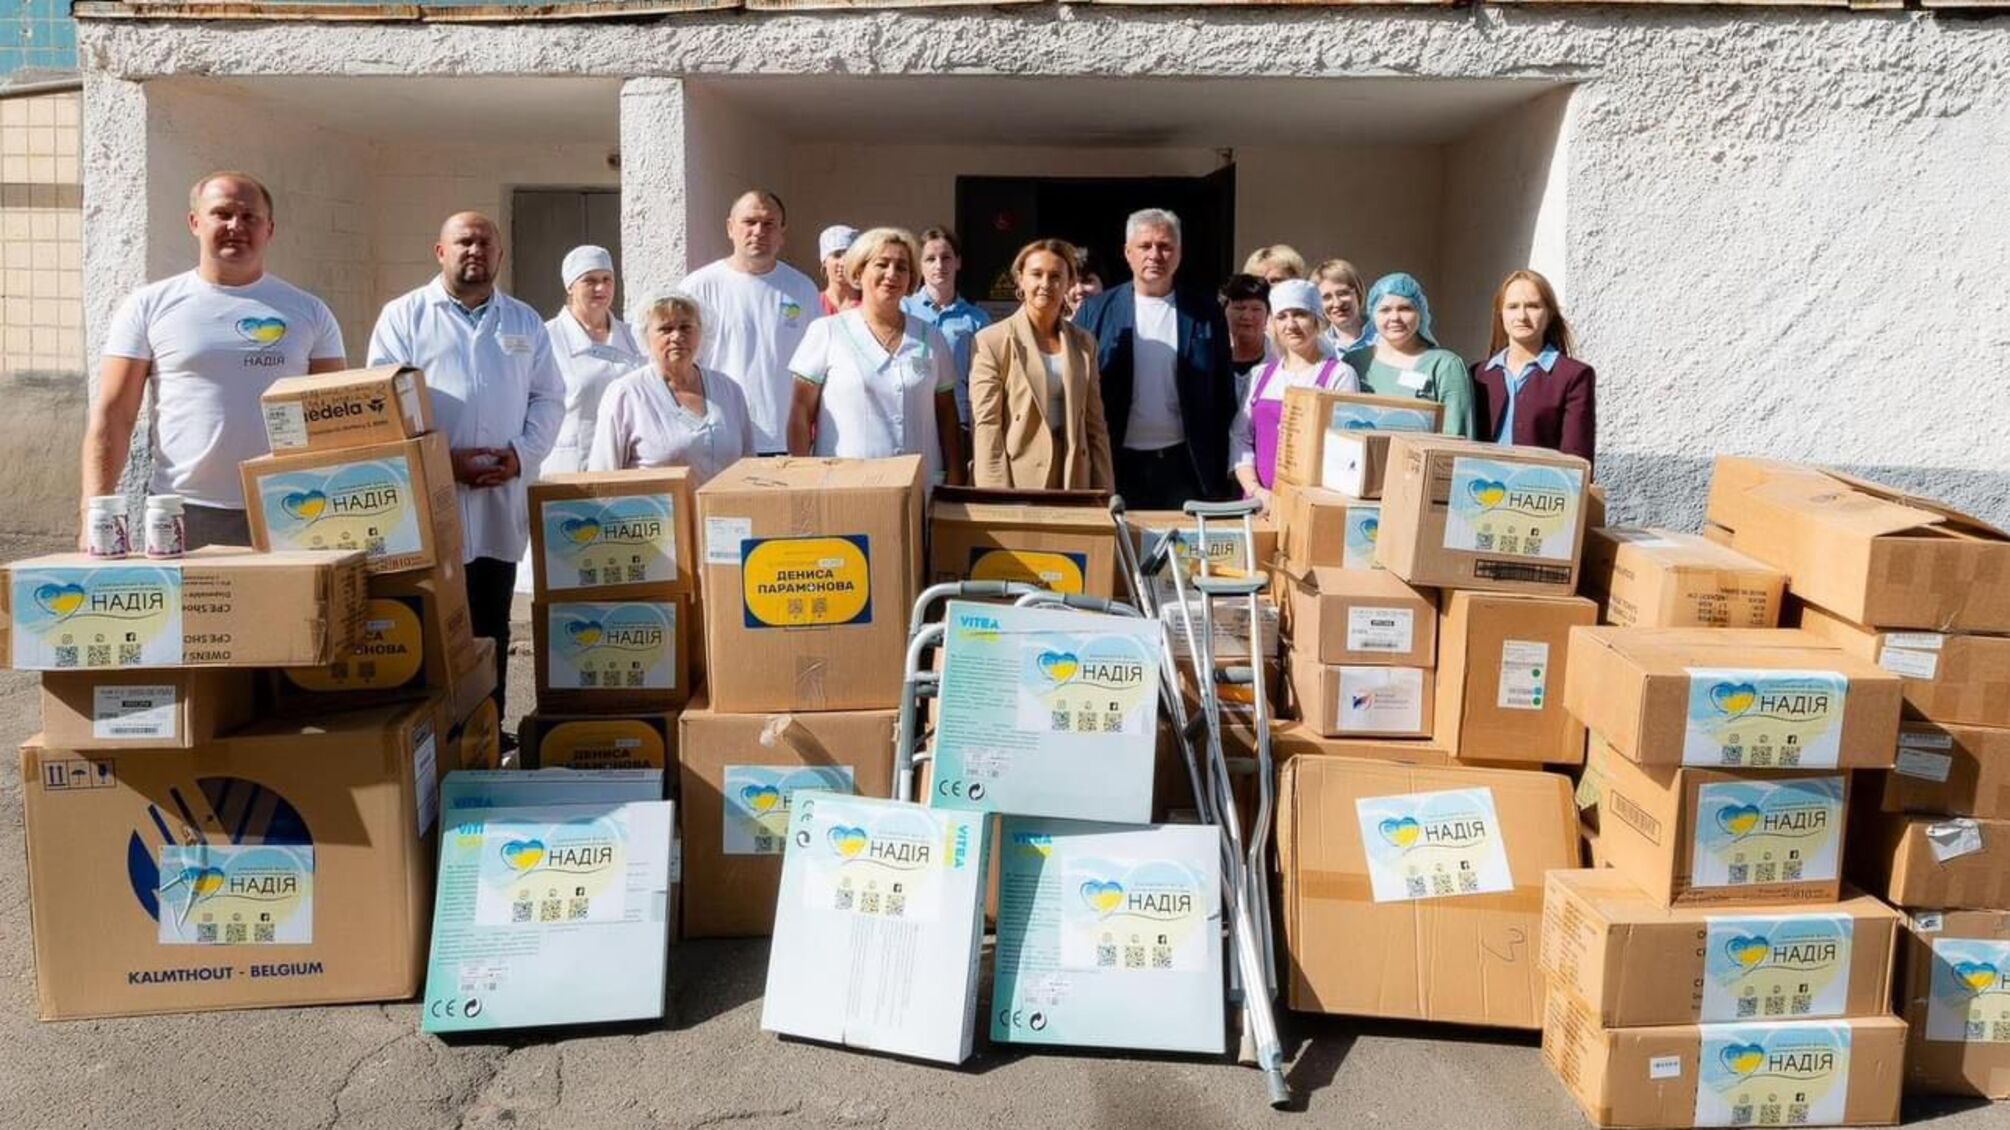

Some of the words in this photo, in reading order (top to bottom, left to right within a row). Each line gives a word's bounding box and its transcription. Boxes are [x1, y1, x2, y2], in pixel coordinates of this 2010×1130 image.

[243, 355, 285, 367] НАДІЯ
[332, 489, 398, 512] НАДІЯ
[1509, 491, 1565, 512] НАДІЯ
[604, 521, 662, 539] НАДІЯ
[1189, 543, 1234, 556] НДІЯ
[777, 569, 834, 582] ДЕНИСА
[758, 580, 855, 594] ПАРАМОНОВА
[91, 591, 164, 611] НАДІЯ
[209, 604, 231, 613] CPE
[959, 615, 1000, 630] VITEA
[209, 634, 231, 643] CPE
[606, 630, 662, 645] НАДІЯ
[189, 650, 231, 660] OWENS
[1082, 664, 1143, 683] НАДІЯ
[1760, 695, 1828, 714] НАДІЯ
[1763, 810, 1826, 831] НАДІЯ
[1425, 820, 1486, 843] НАДІЯ
[870, 838, 931, 863] НАДІЯ
[953, 824, 969, 869] VITEA
[549, 846, 612, 867] НАДІЯ
[230, 876, 297, 895] НАДІЯ
[1128, 893, 1191, 913] НАДІЯ
[1773, 943, 1836, 965] НАДІЯ
[128, 966, 234, 986] KALMTHOUT
[251, 961, 323, 978] BELGIUM
[1768, 1052, 1833, 1073] НАДІЯ
